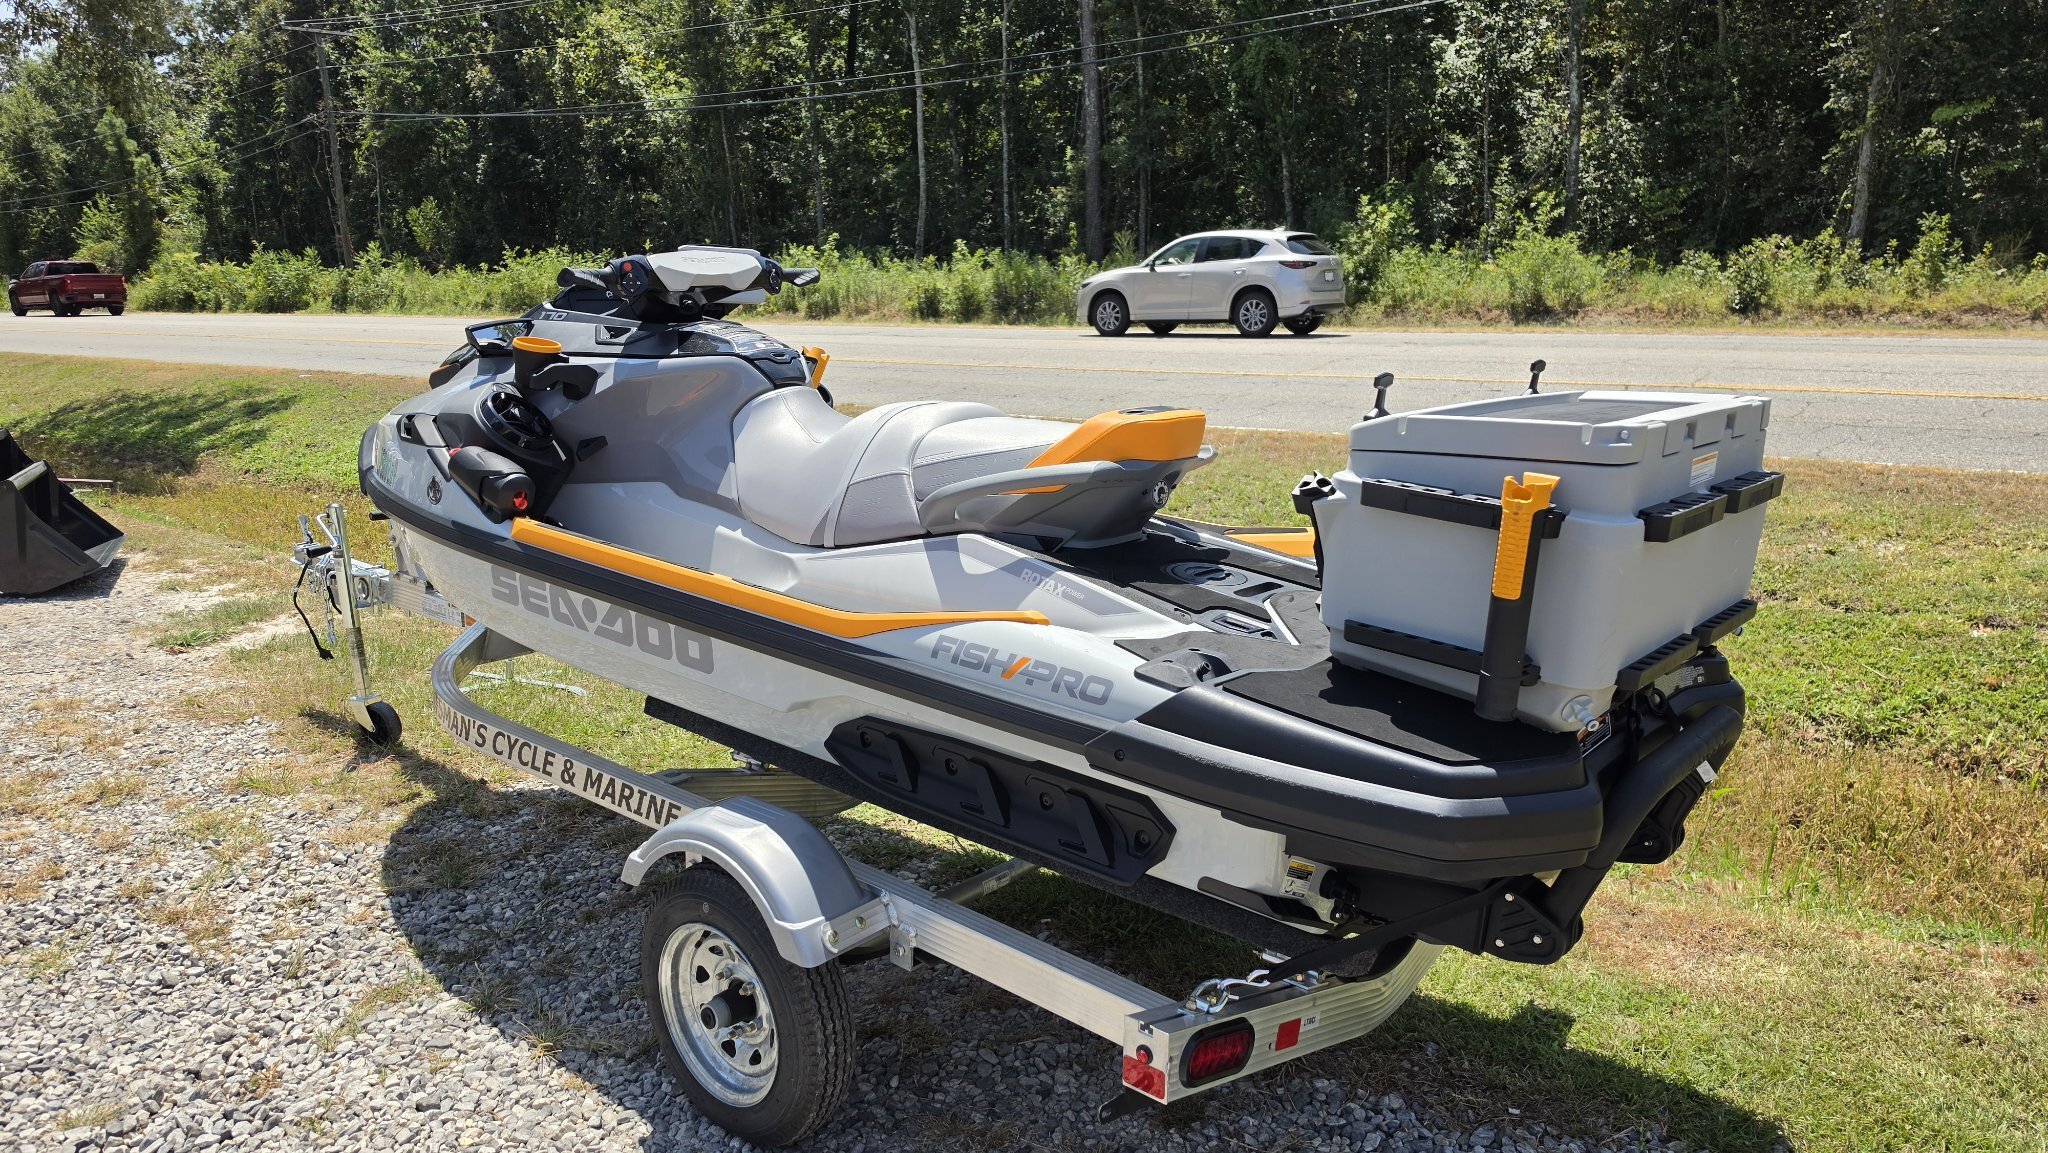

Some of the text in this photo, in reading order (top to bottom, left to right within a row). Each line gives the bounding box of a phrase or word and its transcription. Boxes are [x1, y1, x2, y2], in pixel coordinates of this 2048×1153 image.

[539, 311, 568, 321] 170
[1020, 568, 1085, 600] ROTAX POWER
[492, 730, 556, 778] CYCLE
[560, 758, 575, 787] &
[582, 767, 682, 827] MARINE
